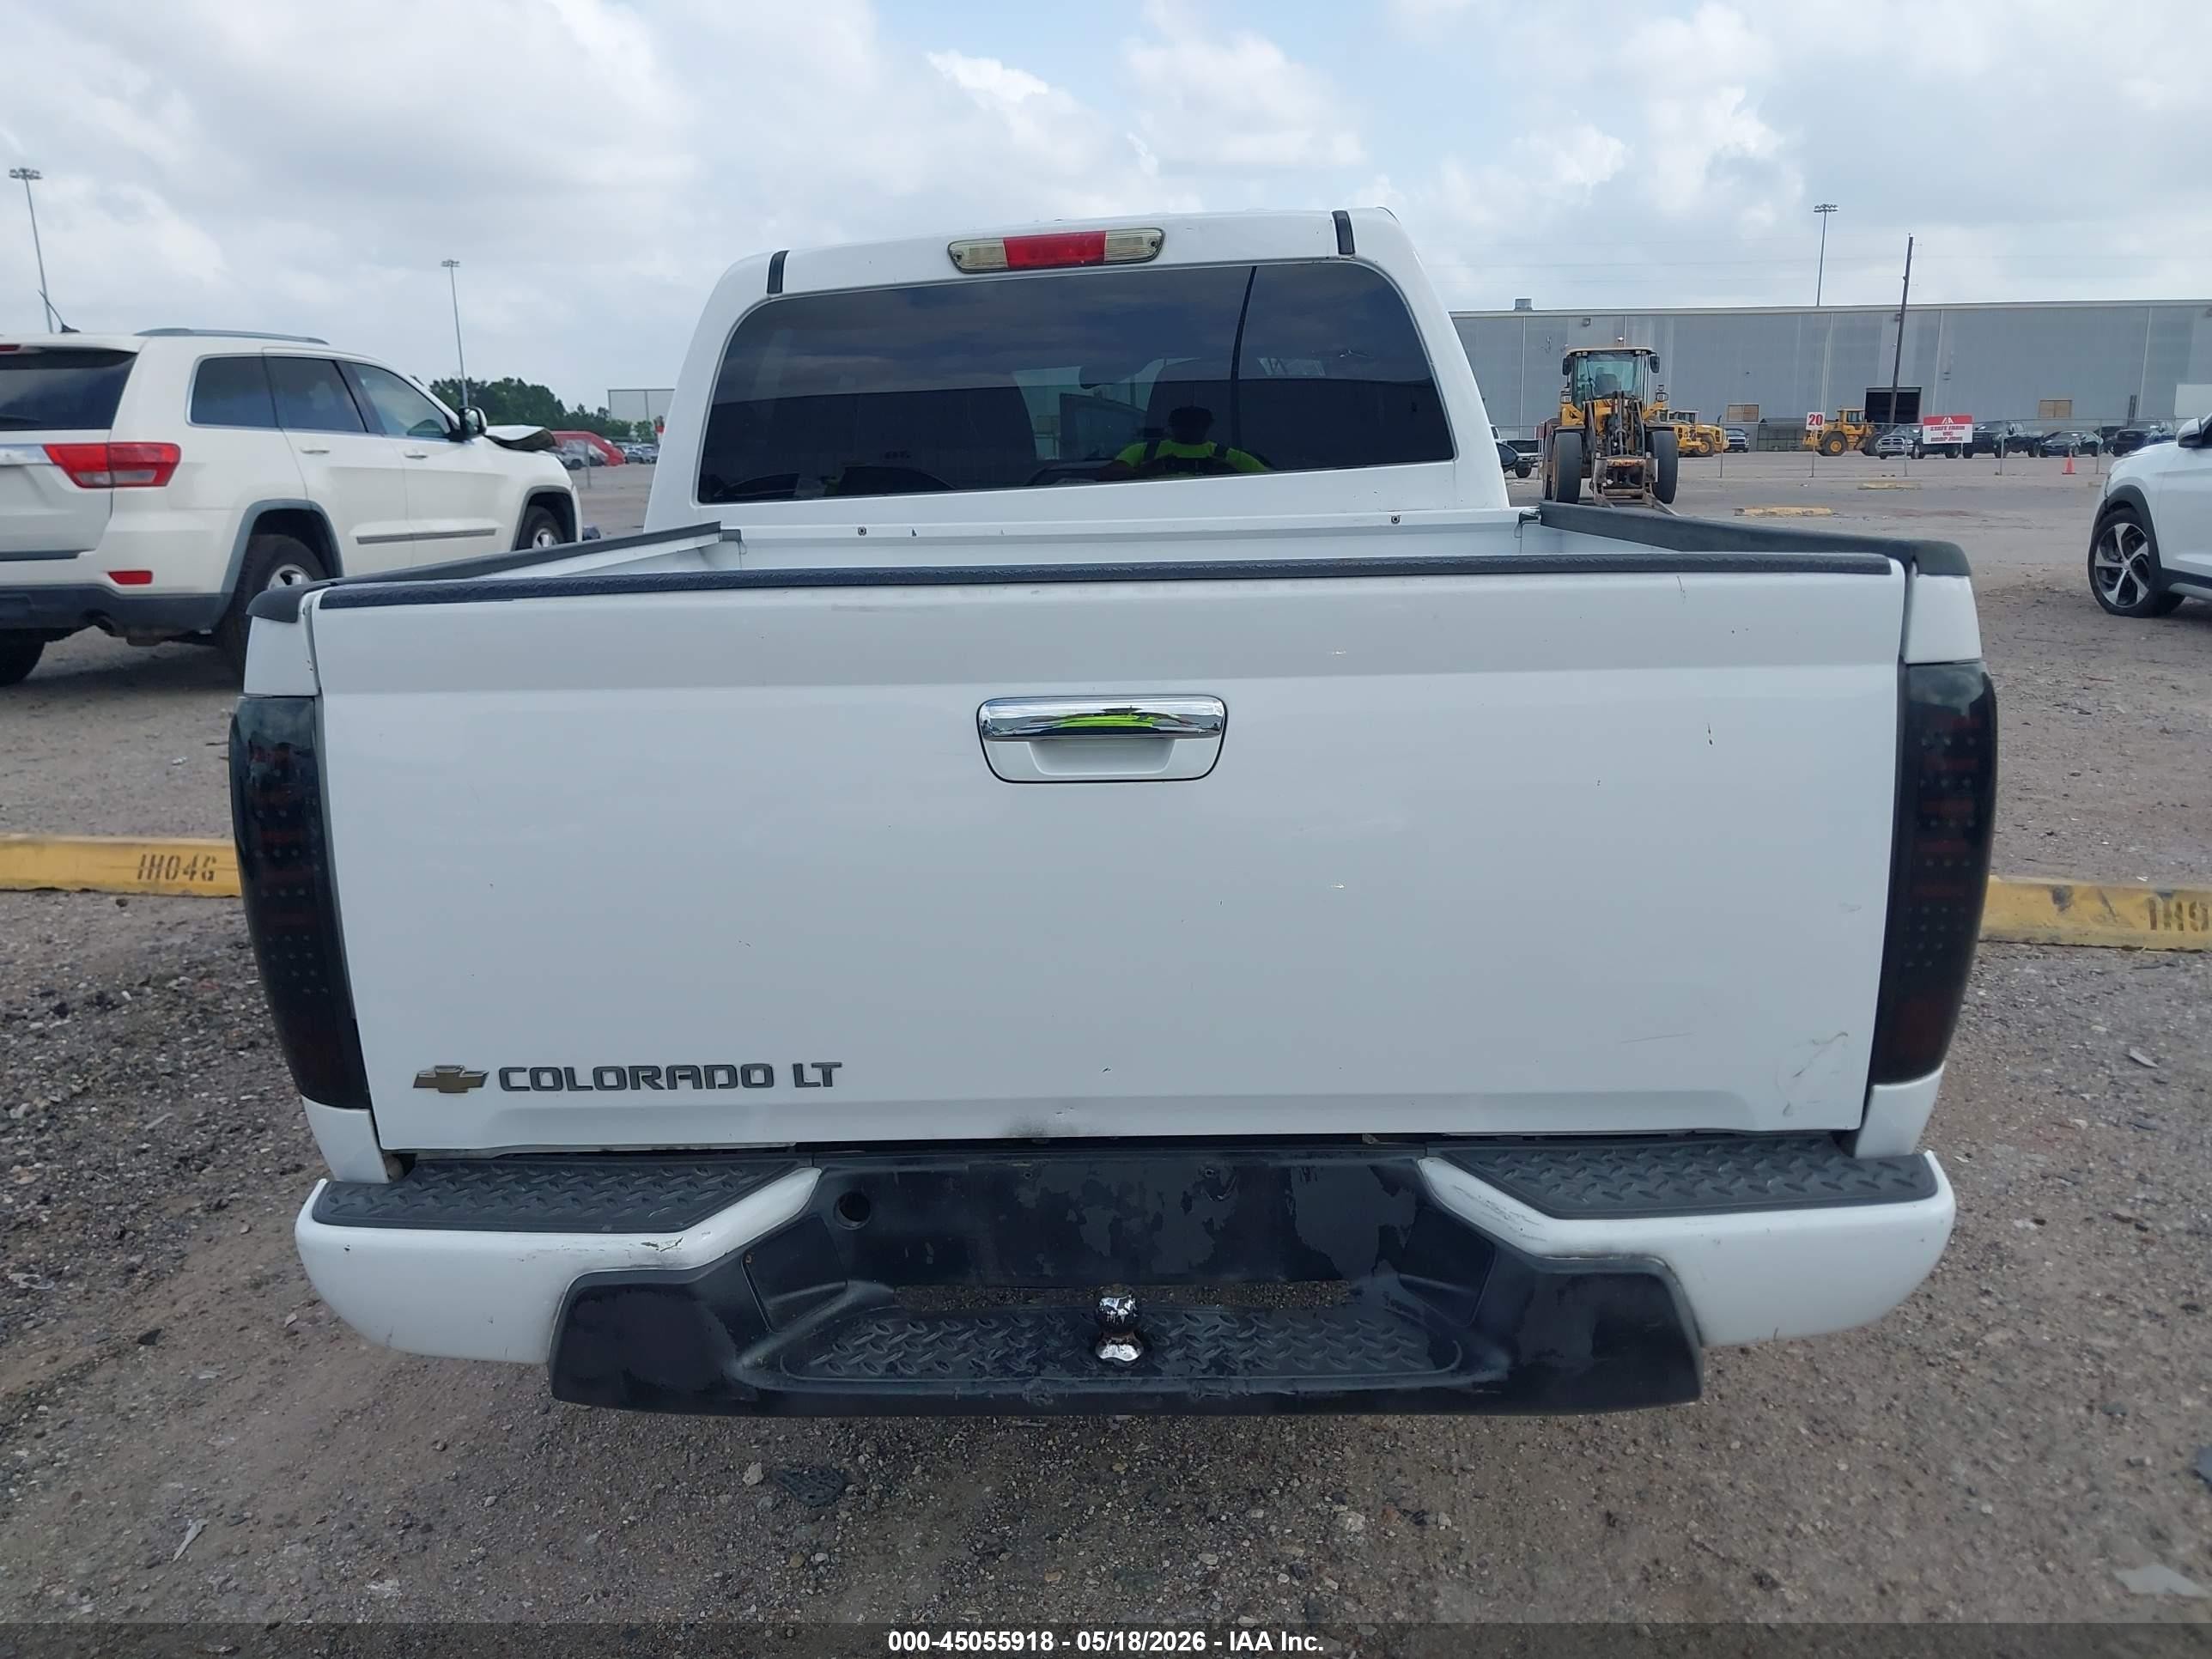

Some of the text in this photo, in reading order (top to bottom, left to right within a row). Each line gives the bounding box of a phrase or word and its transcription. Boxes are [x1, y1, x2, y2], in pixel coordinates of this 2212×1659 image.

[1808, 414, 1824, 426] 20
[499, 1061, 843, 1092] COLORADO LT
